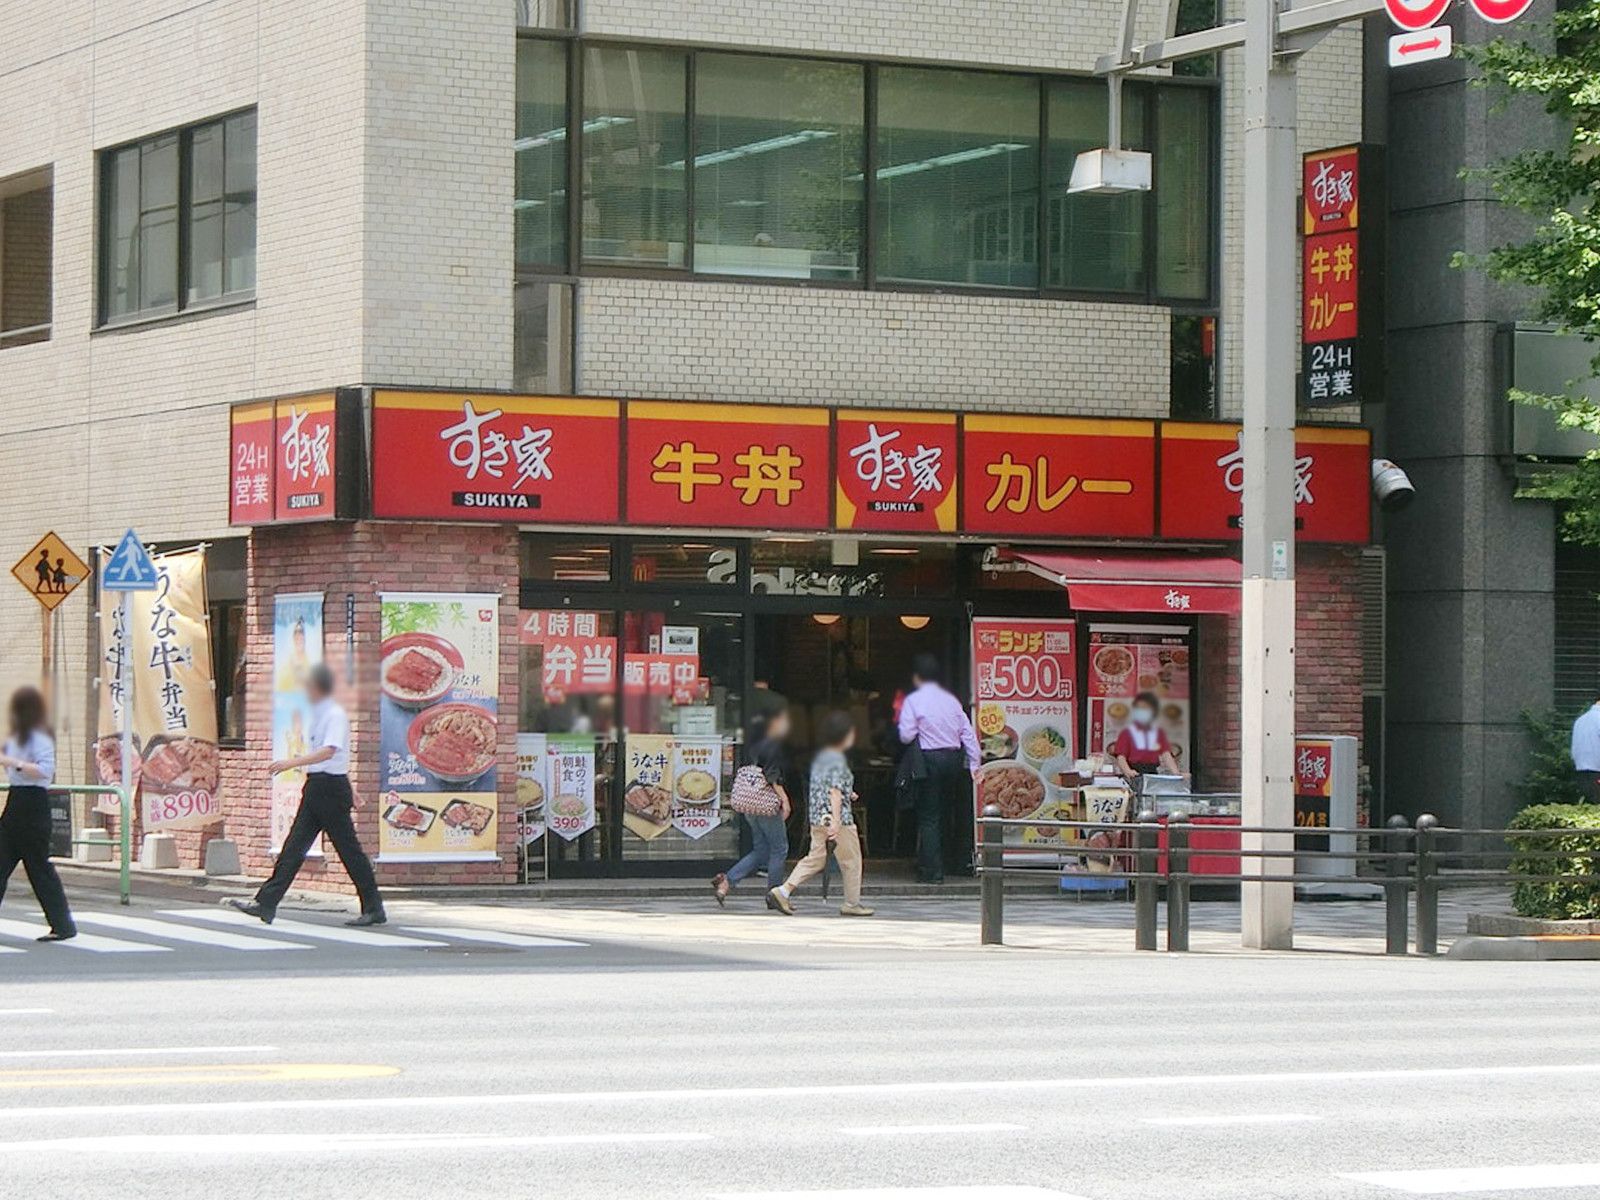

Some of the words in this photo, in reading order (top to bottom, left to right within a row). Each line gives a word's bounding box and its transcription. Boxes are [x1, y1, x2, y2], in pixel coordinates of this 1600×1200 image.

[1312, 161, 1353, 210] すき家
[1310, 243, 1354, 284] 牛丼
[1309, 293, 1354, 331] カレー
[1312, 345, 1352, 369] 24H
[1310, 371, 1353, 399] 営業
[236, 442, 269, 472] 24H
[282, 403, 331, 488] すき家
[440, 399, 554, 490] すき家
[651, 441, 804, 506] 牛丼
[849, 423, 943, 500] すき家
[234, 474, 269, 506] 営業
[986, 452, 1134, 514] カレー
[290, 493, 321, 509] SUKIYA
[463, 493, 529, 509] SUKIYA
[874, 501, 917, 512] SUKIYA
[523, 611, 598, 638] 4時間
[149, 566, 188, 731] うな牛弁当
[999, 630, 1044, 653] ランチ
[544, 643, 613, 685] 弁当
[623, 660, 696, 686] 販売中
[562, 755, 576, 783] 朝食
[631, 752, 669, 768] うな牛
[637, 770, 662, 784] 弁当
